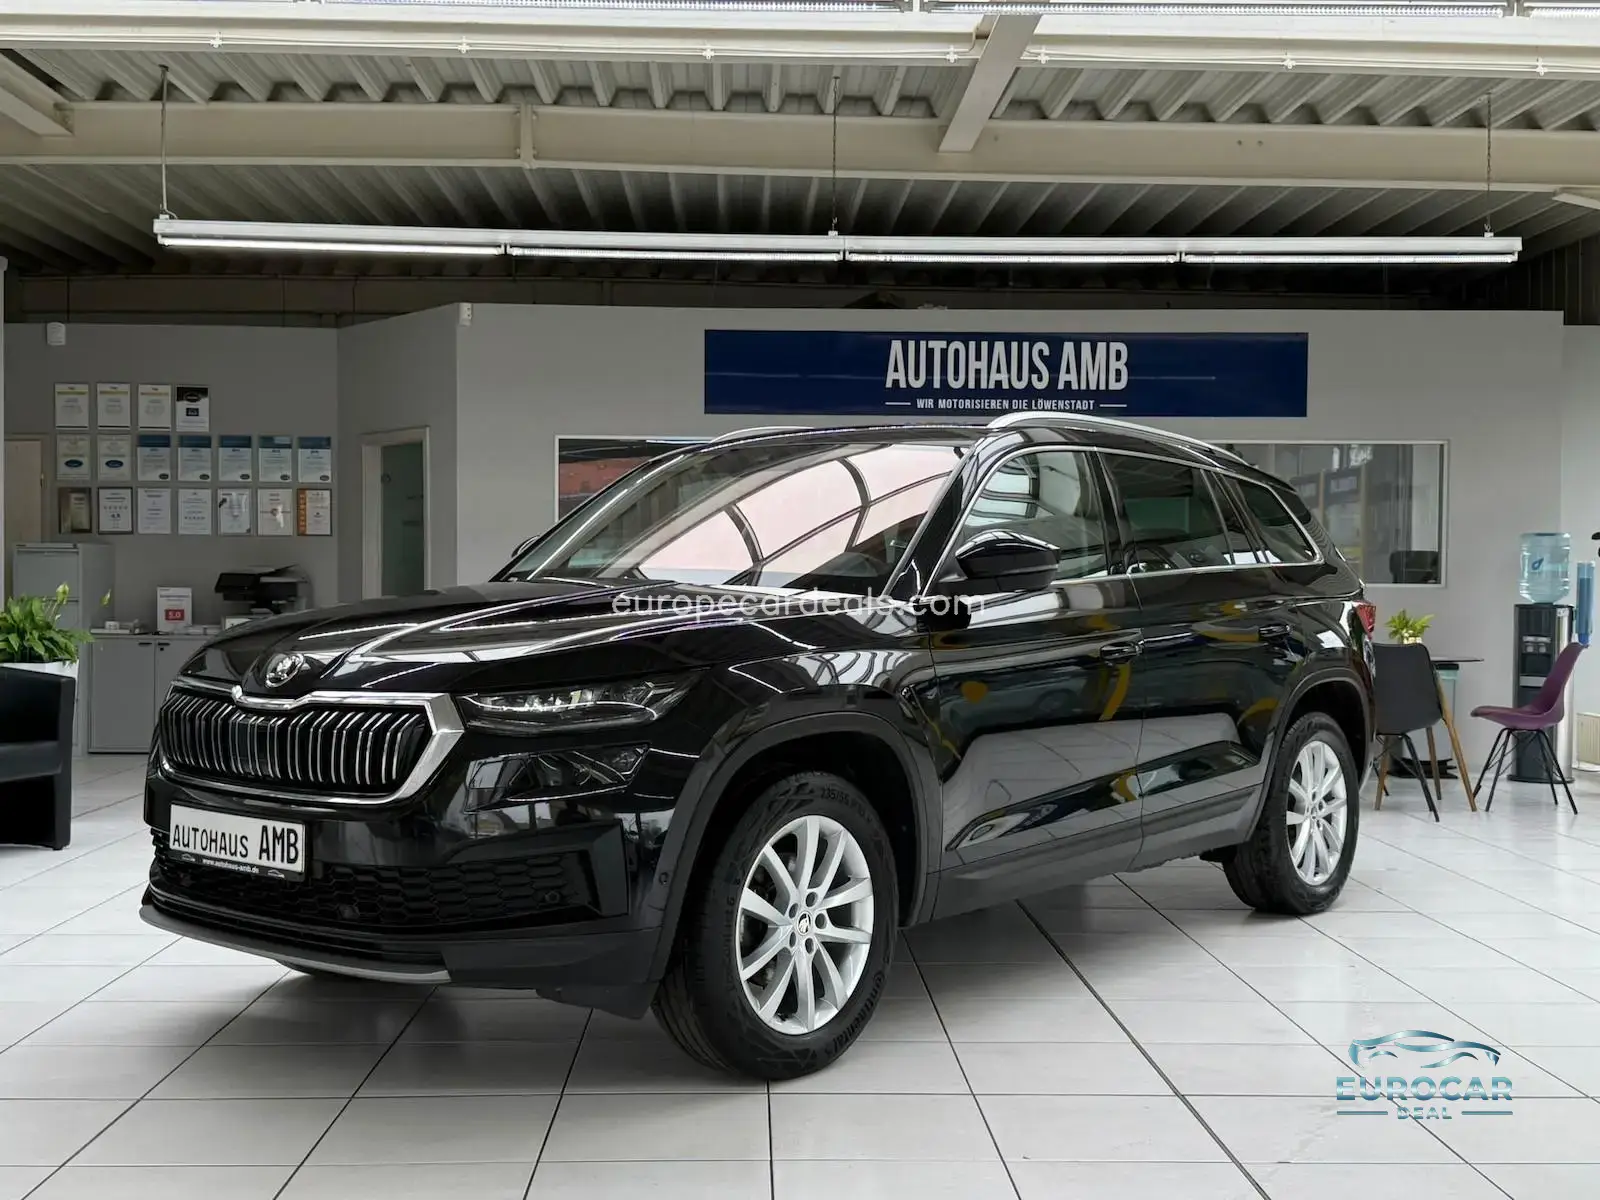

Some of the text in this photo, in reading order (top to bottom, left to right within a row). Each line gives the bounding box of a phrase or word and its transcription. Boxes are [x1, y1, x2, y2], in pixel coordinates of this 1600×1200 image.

[885, 340, 1129, 391] AUTOHAUS AMB
[916, 398, 1095, 410] WIR MOTORISIEREN DIE LÖWENSTADT
[172, 824, 299, 864] AUTOHAUS AMB
